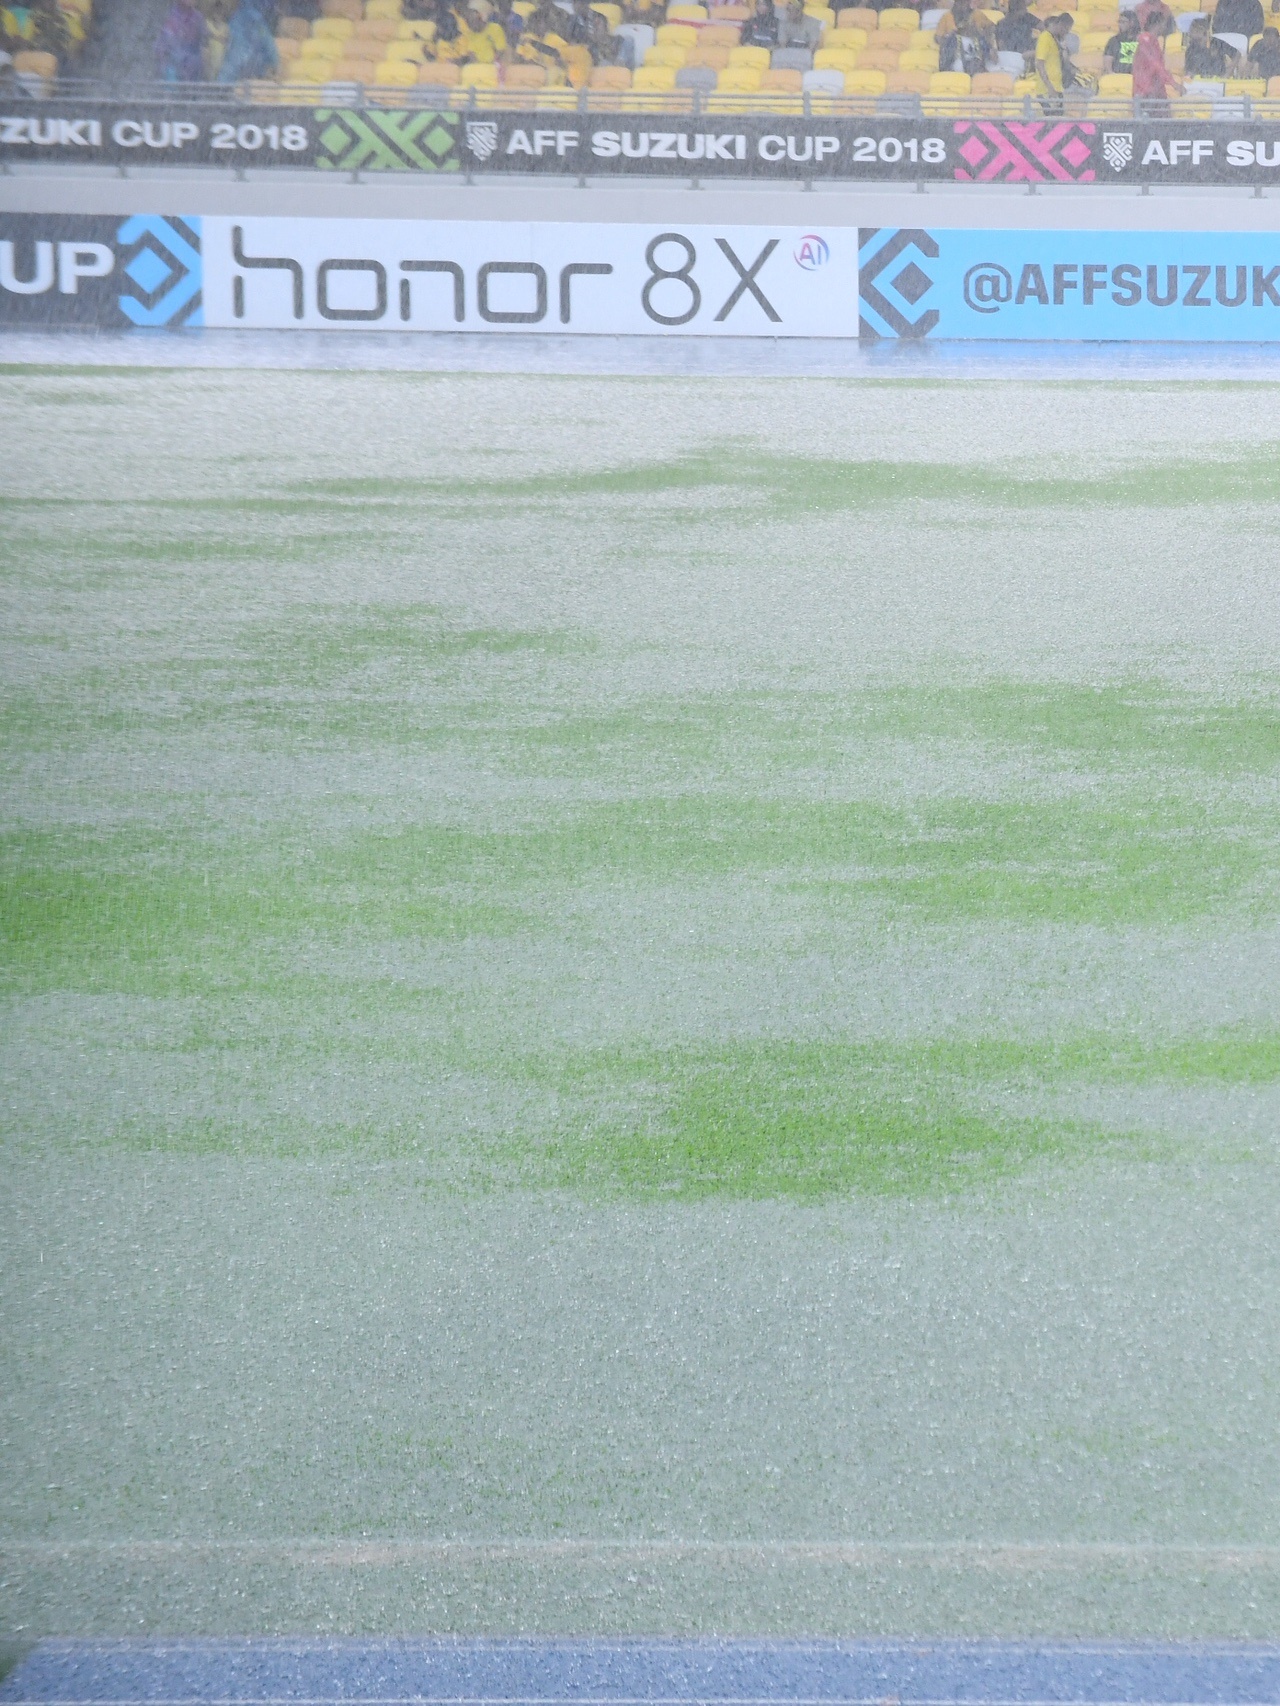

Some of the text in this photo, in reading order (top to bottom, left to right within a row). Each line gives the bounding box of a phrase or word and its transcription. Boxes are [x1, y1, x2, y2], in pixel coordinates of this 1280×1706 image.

[0, 118, 308, 151] ZUKI CUP 2018
[507, 130, 946, 163] AFF SUZUKI CUP 2018
[1142, 140, 1214, 165] AFF
[0, 240, 115, 294] UP
[800, 243, 822, 265] AI
[232, 224, 783, 325] honor 8X
